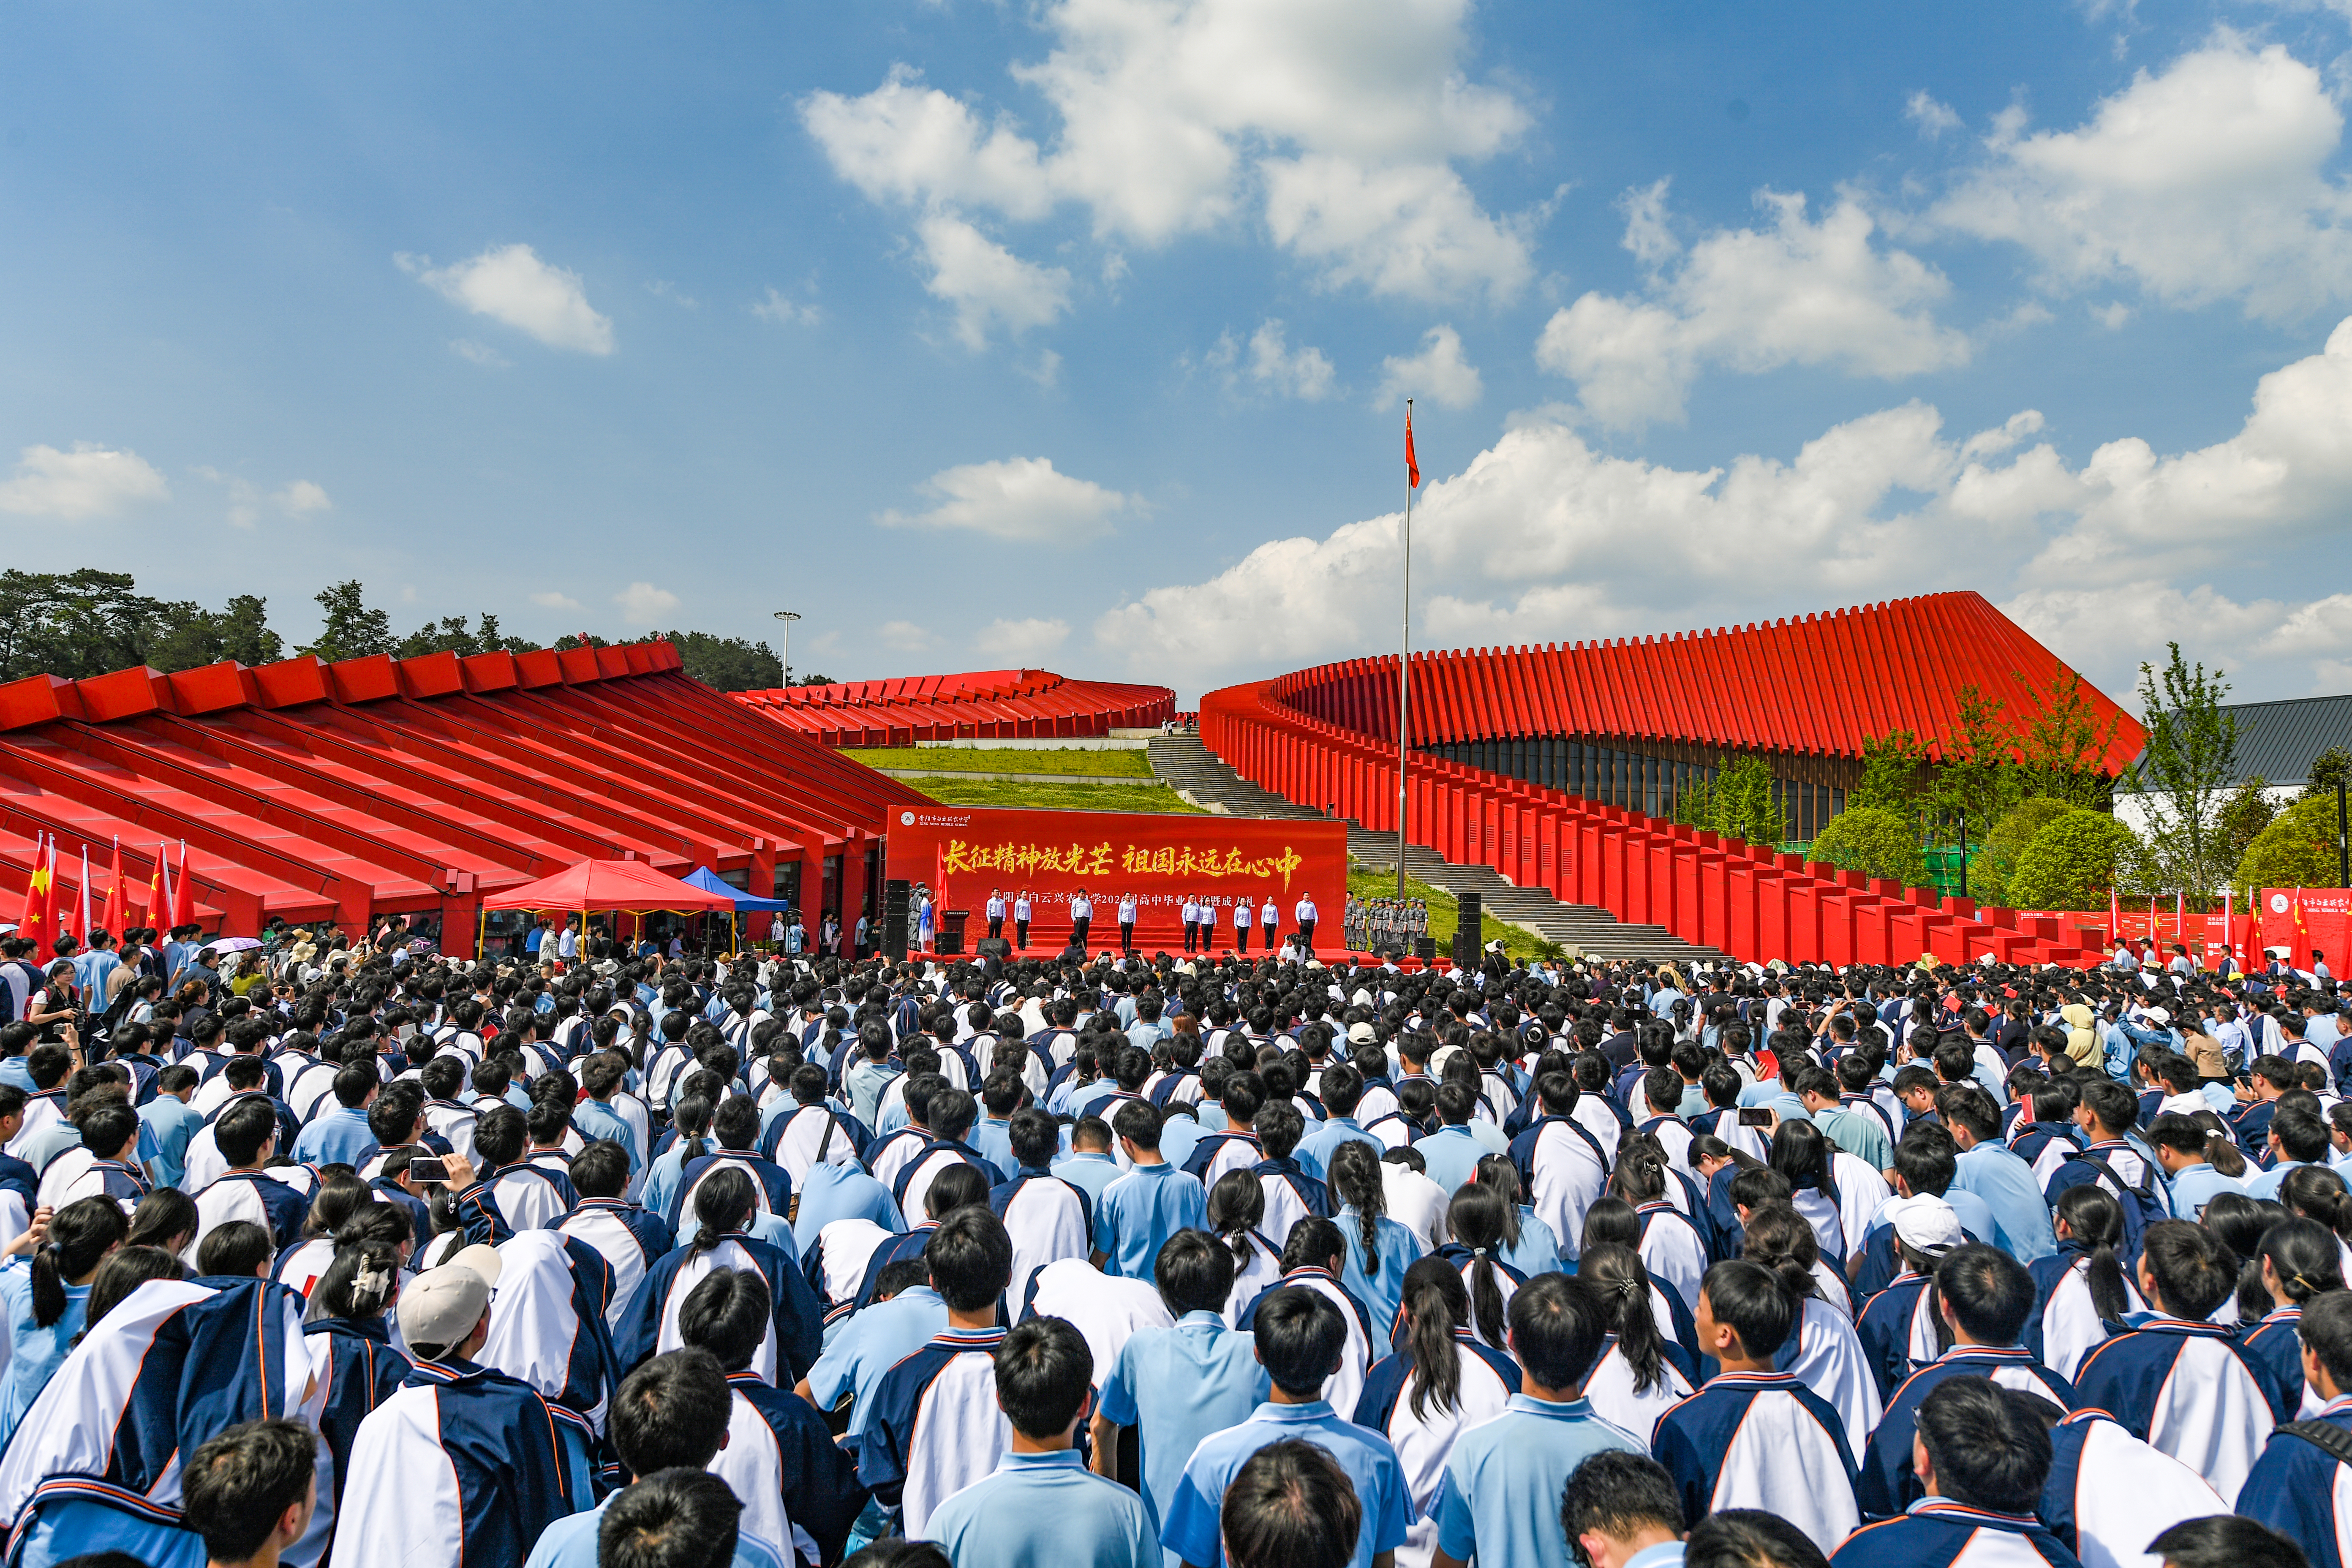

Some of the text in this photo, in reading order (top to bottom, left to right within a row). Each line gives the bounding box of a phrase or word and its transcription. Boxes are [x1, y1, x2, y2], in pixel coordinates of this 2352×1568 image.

[918, 814, 968, 823] 贵阳市白云兴农中学
[944, 839, 1302, 894] 长征精神放光芒 祖国永远在心中
